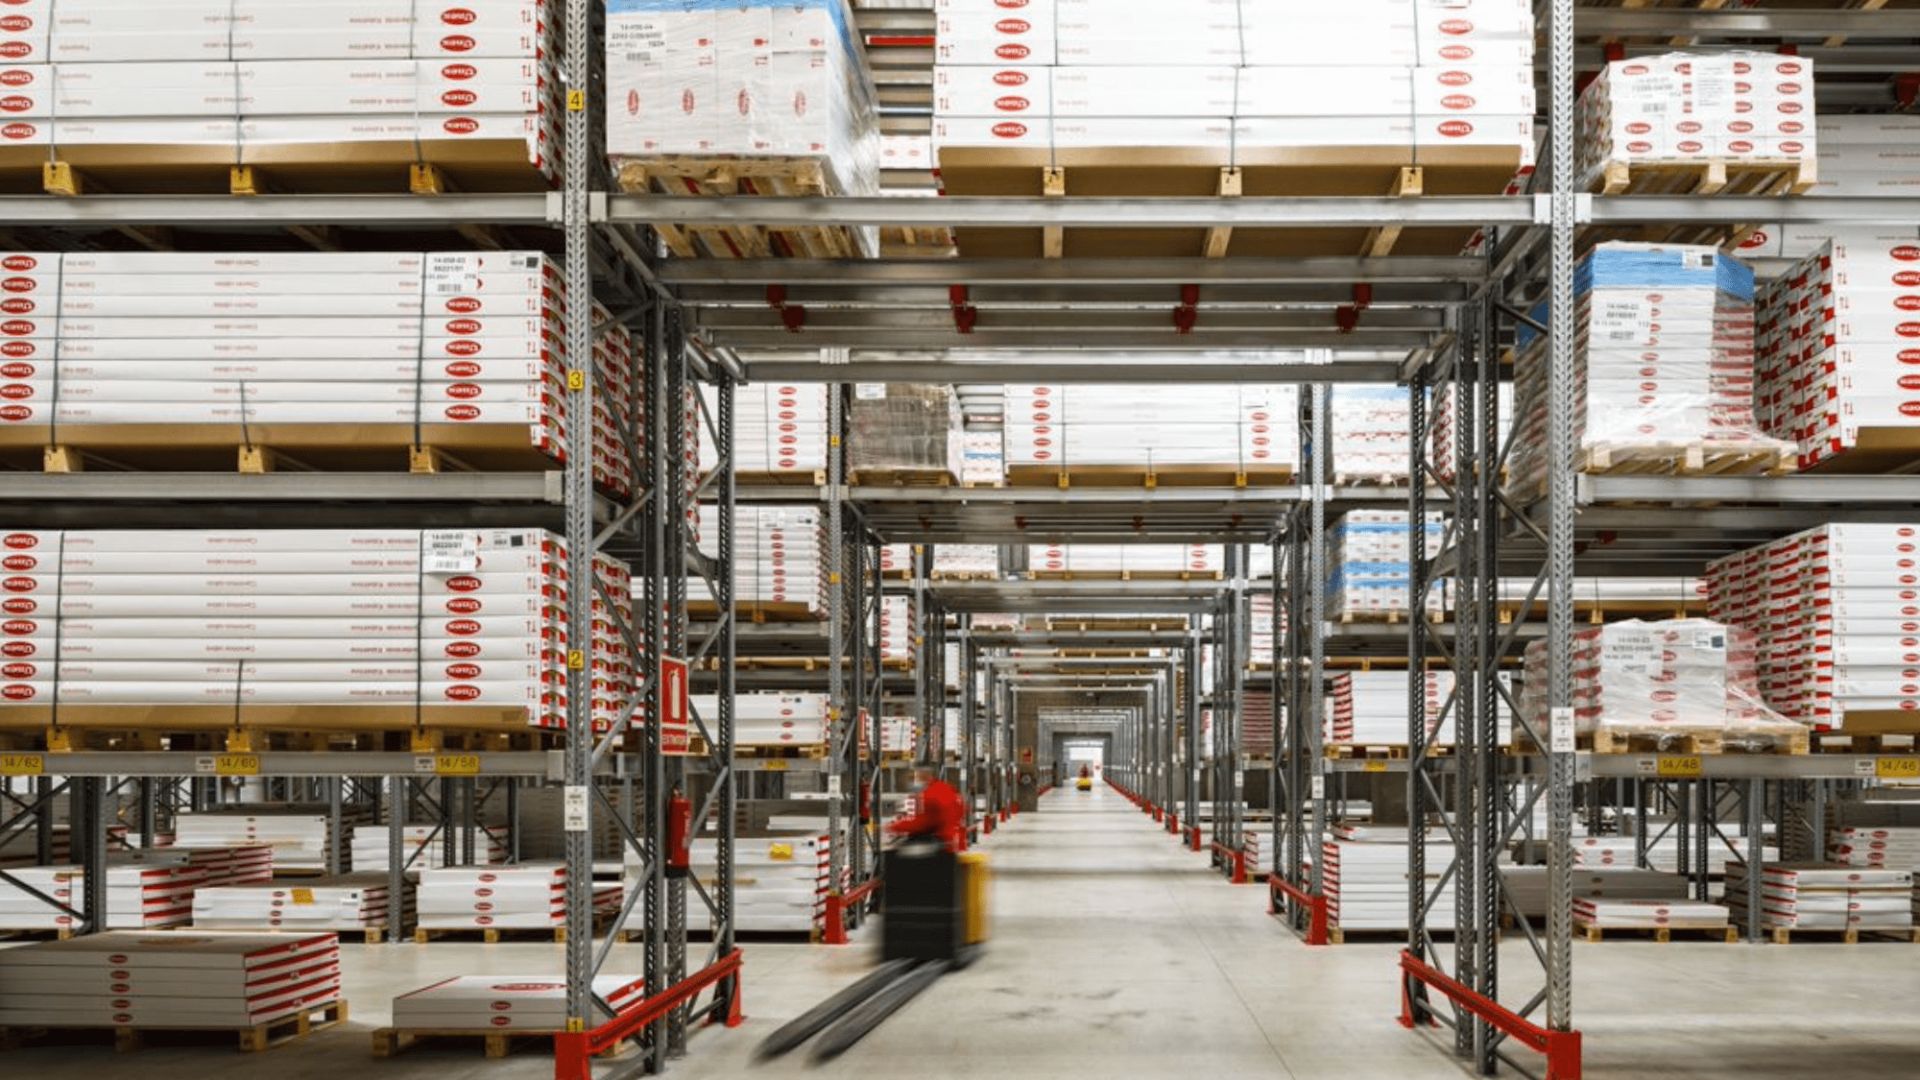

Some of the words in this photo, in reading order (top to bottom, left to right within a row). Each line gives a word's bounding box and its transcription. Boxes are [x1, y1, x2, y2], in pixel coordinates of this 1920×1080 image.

[571, 92, 580, 106] 4
[571, 372, 581, 387] 3
[571, 652, 581, 667] 2
